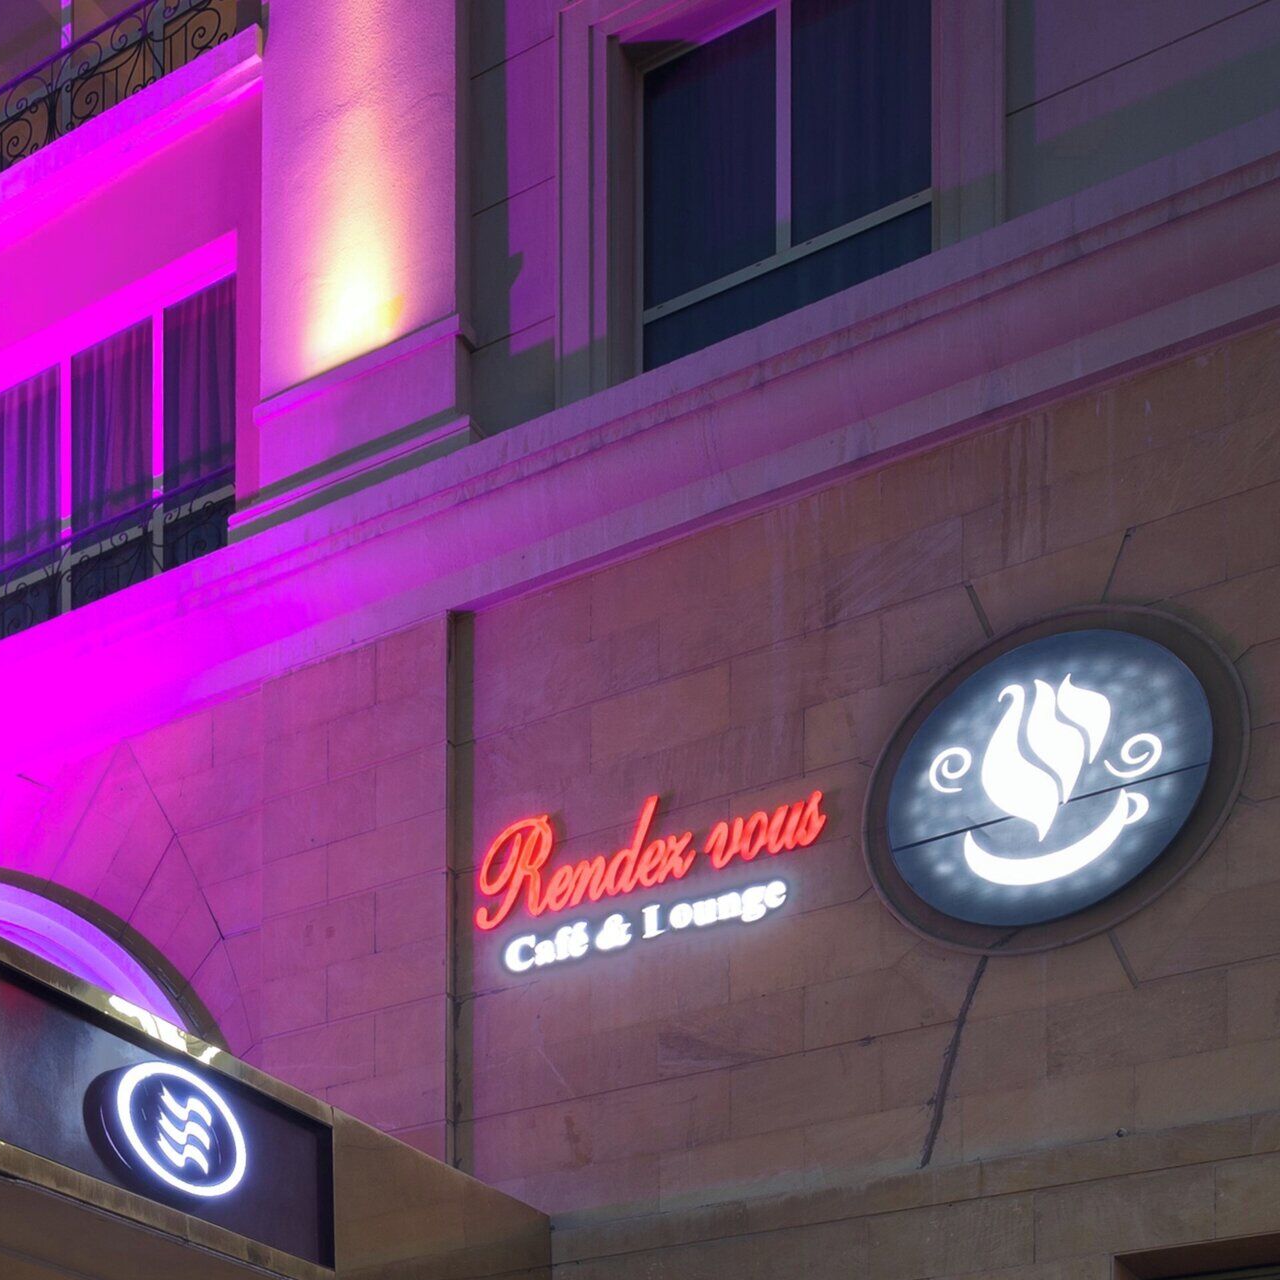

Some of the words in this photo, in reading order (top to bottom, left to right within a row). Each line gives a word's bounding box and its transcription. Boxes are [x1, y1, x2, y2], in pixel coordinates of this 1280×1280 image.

[475, 795, 696, 931] Rendez
[704, 790, 827, 869] vous
[504, 920, 591, 973] Café
[594, 913, 632, 952] &
[642, 879, 788, 940] Lounge
